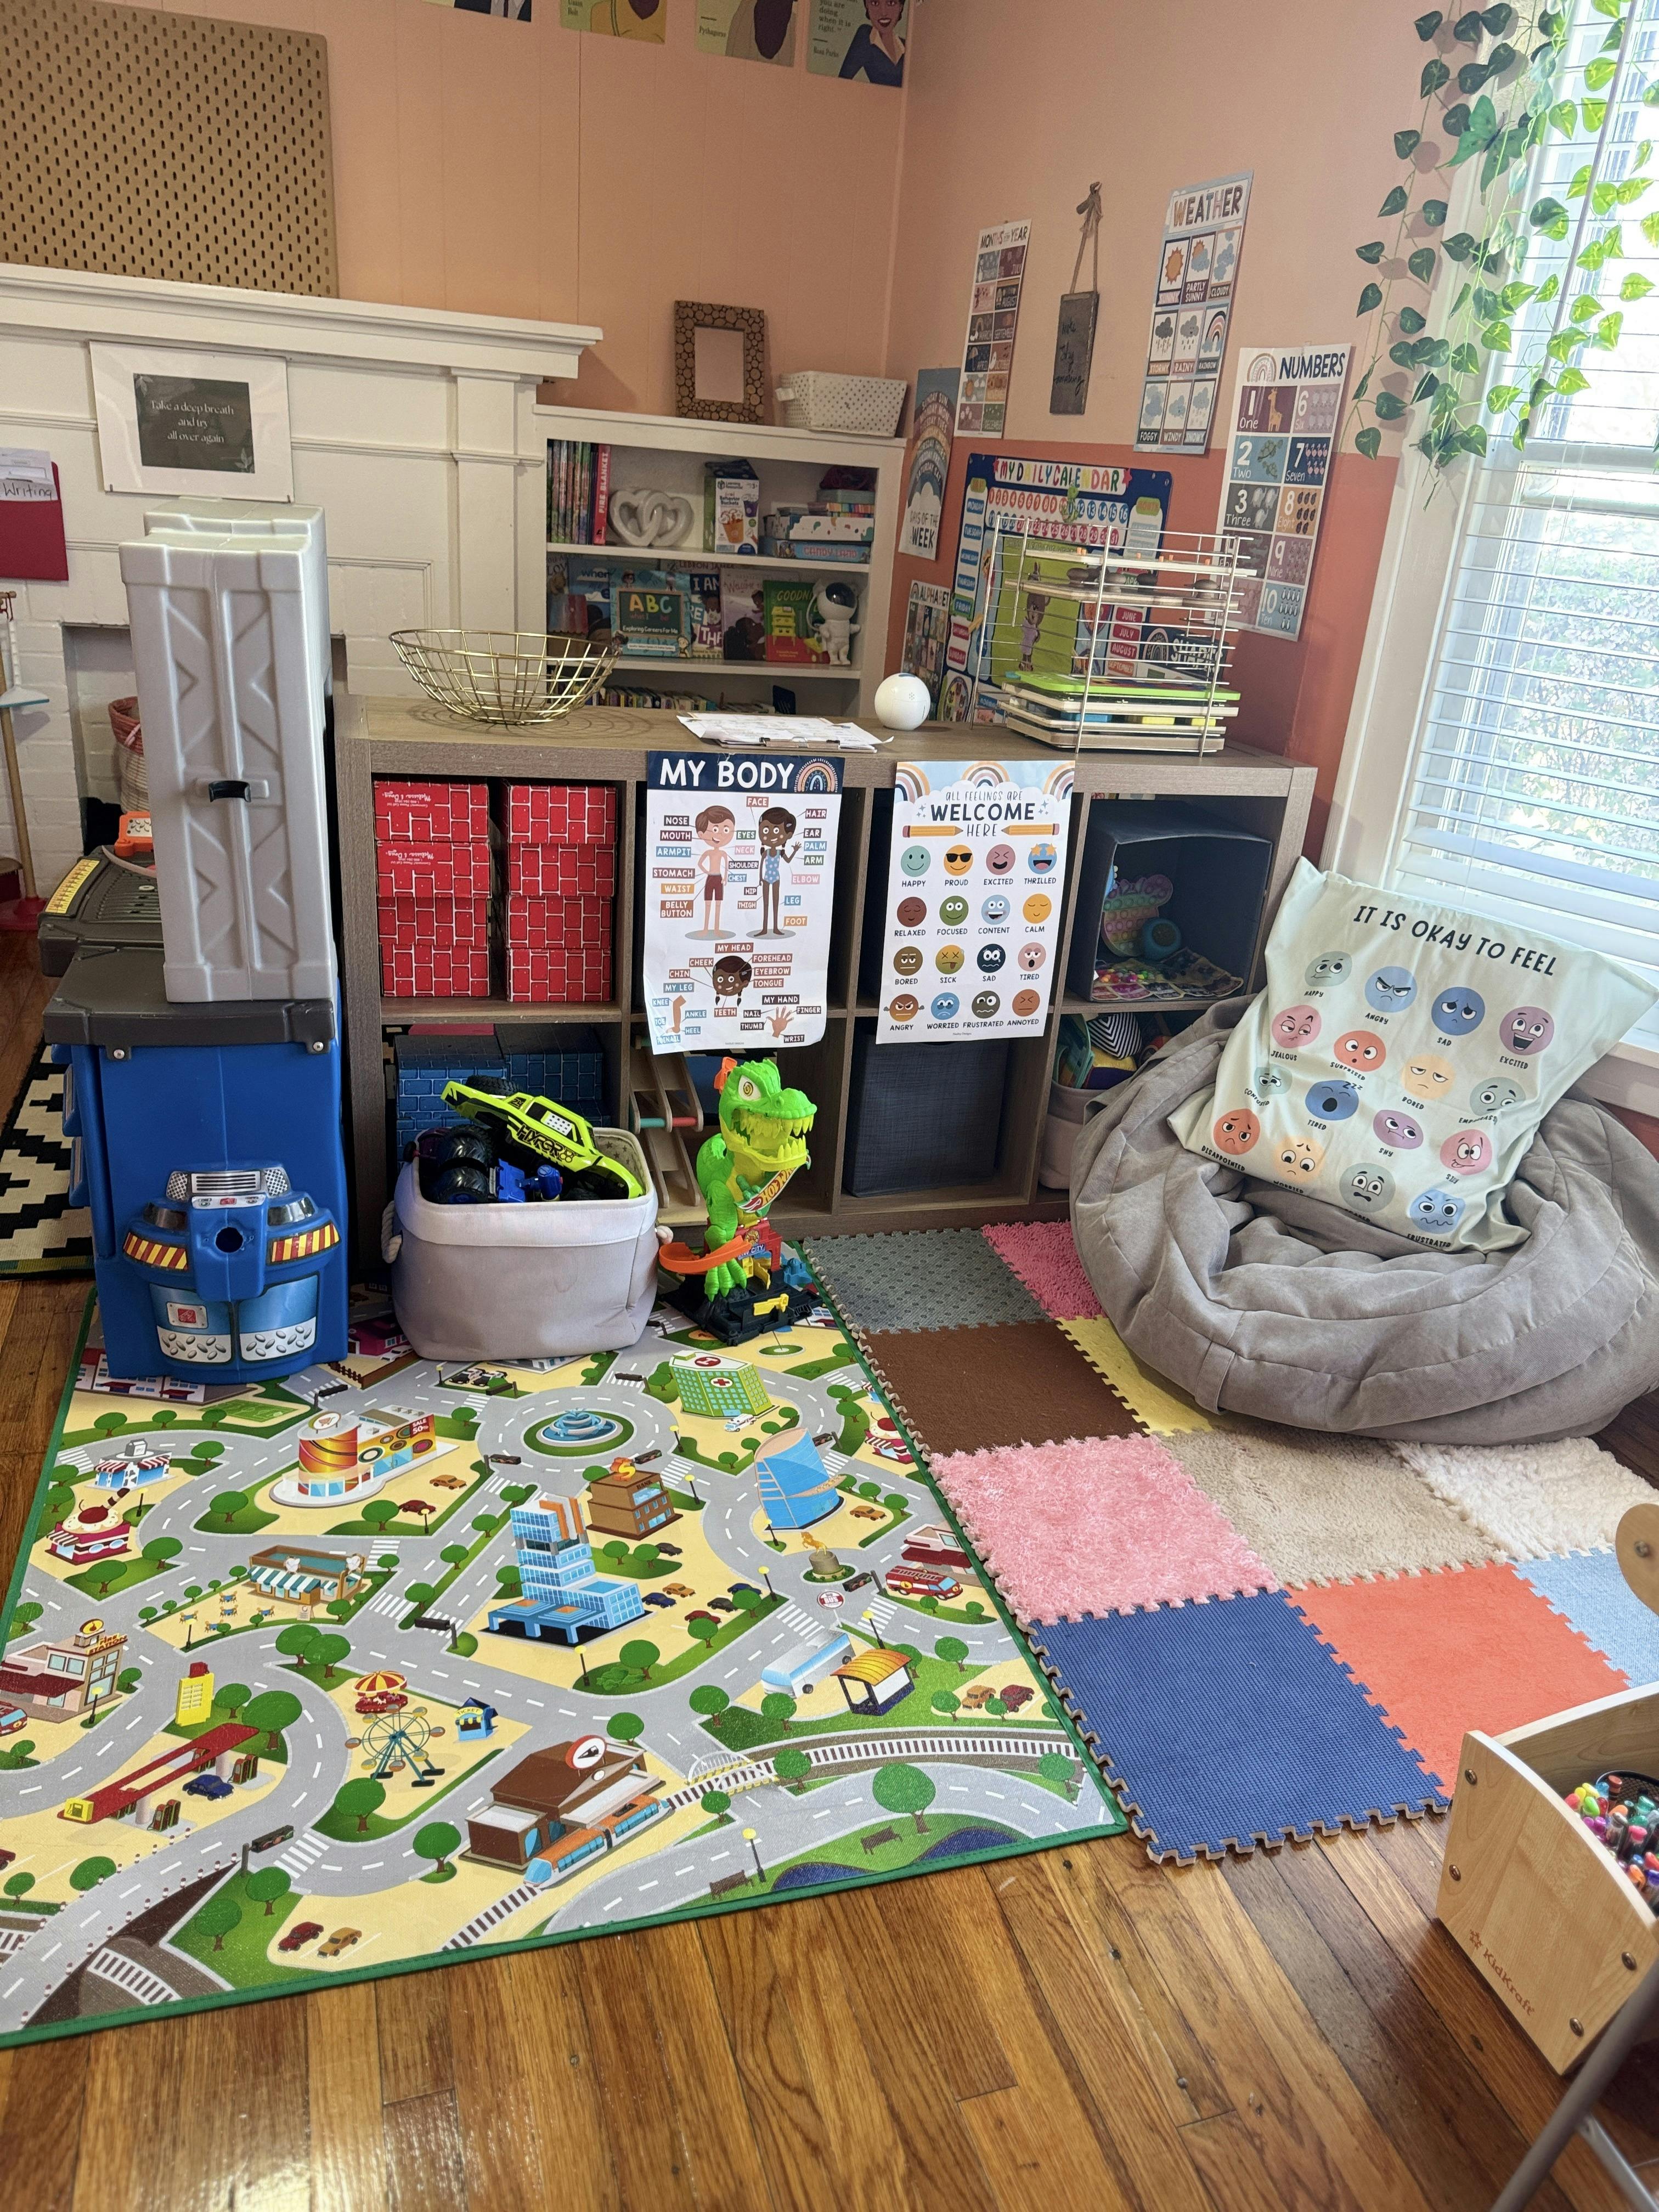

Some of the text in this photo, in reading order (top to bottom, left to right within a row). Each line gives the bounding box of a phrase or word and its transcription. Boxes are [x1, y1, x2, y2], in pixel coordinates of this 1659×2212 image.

[1173, 185, 1243, 228] WEATHER
[1186, 281, 1206, 292] PARTLY
[1211, 286, 1229, 296] CLOUDY
[1185, 292, 1203, 302] SUNNY
[1175, 362, 1194, 373] RAINY
[1279, 352, 1345, 380] NUMBERS
[151, 400, 172, 410] Take
[180, 402, 202, 415] deep
[205, 403, 234, 414] breath
[1248, 390, 1256, 416] 1
[1297, 390, 1308, 417] 6
[178, 417, 207, 428] and try
[1239, 417, 1259, 430] One
[167, 431, 177, 439] all
[201, 435, 224, 444] again
[1140, 431, 1158, 442] FOGGY
[1164, 432, 1182, 442] WINDY
[1237, 441, 1252, 466] 2
[1294, 443, 1305, 469] 7
[600, 452, 608, 491] BLANKET
[1233, 467, 1251, 478] Two
[1285, 470, 1305, 482] Seven
[3, 483, 52, 500] Writing
[1235, 489, 1248, 514] 3
[1284, 490, 1295, 516] 8
[910, 510, 938, 528] DAYS OF THE
[1226, 514, 1251, 527] Three
[912, 526, 935, 549] WEEK
[1275, 540, 1286, 565] 9
[919, 586, 949, 607] ALPHABET
[1261, 588, 1278, 614] 10
[955, 602, 971, 611] FRIDAY
[1122, 612, 1136, 621] JUNE
[1119, 629, 1134, 638] JULY
[1112, 647, 1136, 657] AUGUST
[660, 758, 794, 789] MY BODY
[748, 798, 768, 806] FACE
[965, 791, 1002, 802] FEELINGS
[806, 810, 826, 818] HAIR
[930, 803, 1035, 821] WELCOME
[665, 816, 688, 825] NOSE
[661, 831, 691, 840] MOUTH
[967, 823, 998, 837] HERE
[657, 848, 690, 856] ARMPIT
[1354, 905, 1556, 976] IT IS OKAY TO FEEL
[1365, 1013, 1389, 1025] ANGRY
[1437, 1037, 1452, 1046] SAD
[1271, 1050, 1297, 1061] JEALOUS
[1499, 1056, 1528, 1069] EXCITED
[1330, 1062, 1365, 1081] SURPRISED
[1402, 1096, 1424, 1110] BORED
[1307, 1120, 1327, 1130] TIRED
[1201, 1146, 1245, 1171] DISAPPOINTED
[1379, 1148, 1393, 1156] SHY
[751, 1244, 764, 1254] CITY
[412, 1419, 427, 1427] SALE
[413, 1425, 428, 1435] 50%
[636, 1480, 652, 1489] BANK
[88, 1635, 127, 1654] STATION
[1483, 1948, 1534, 2016] KidKraft
